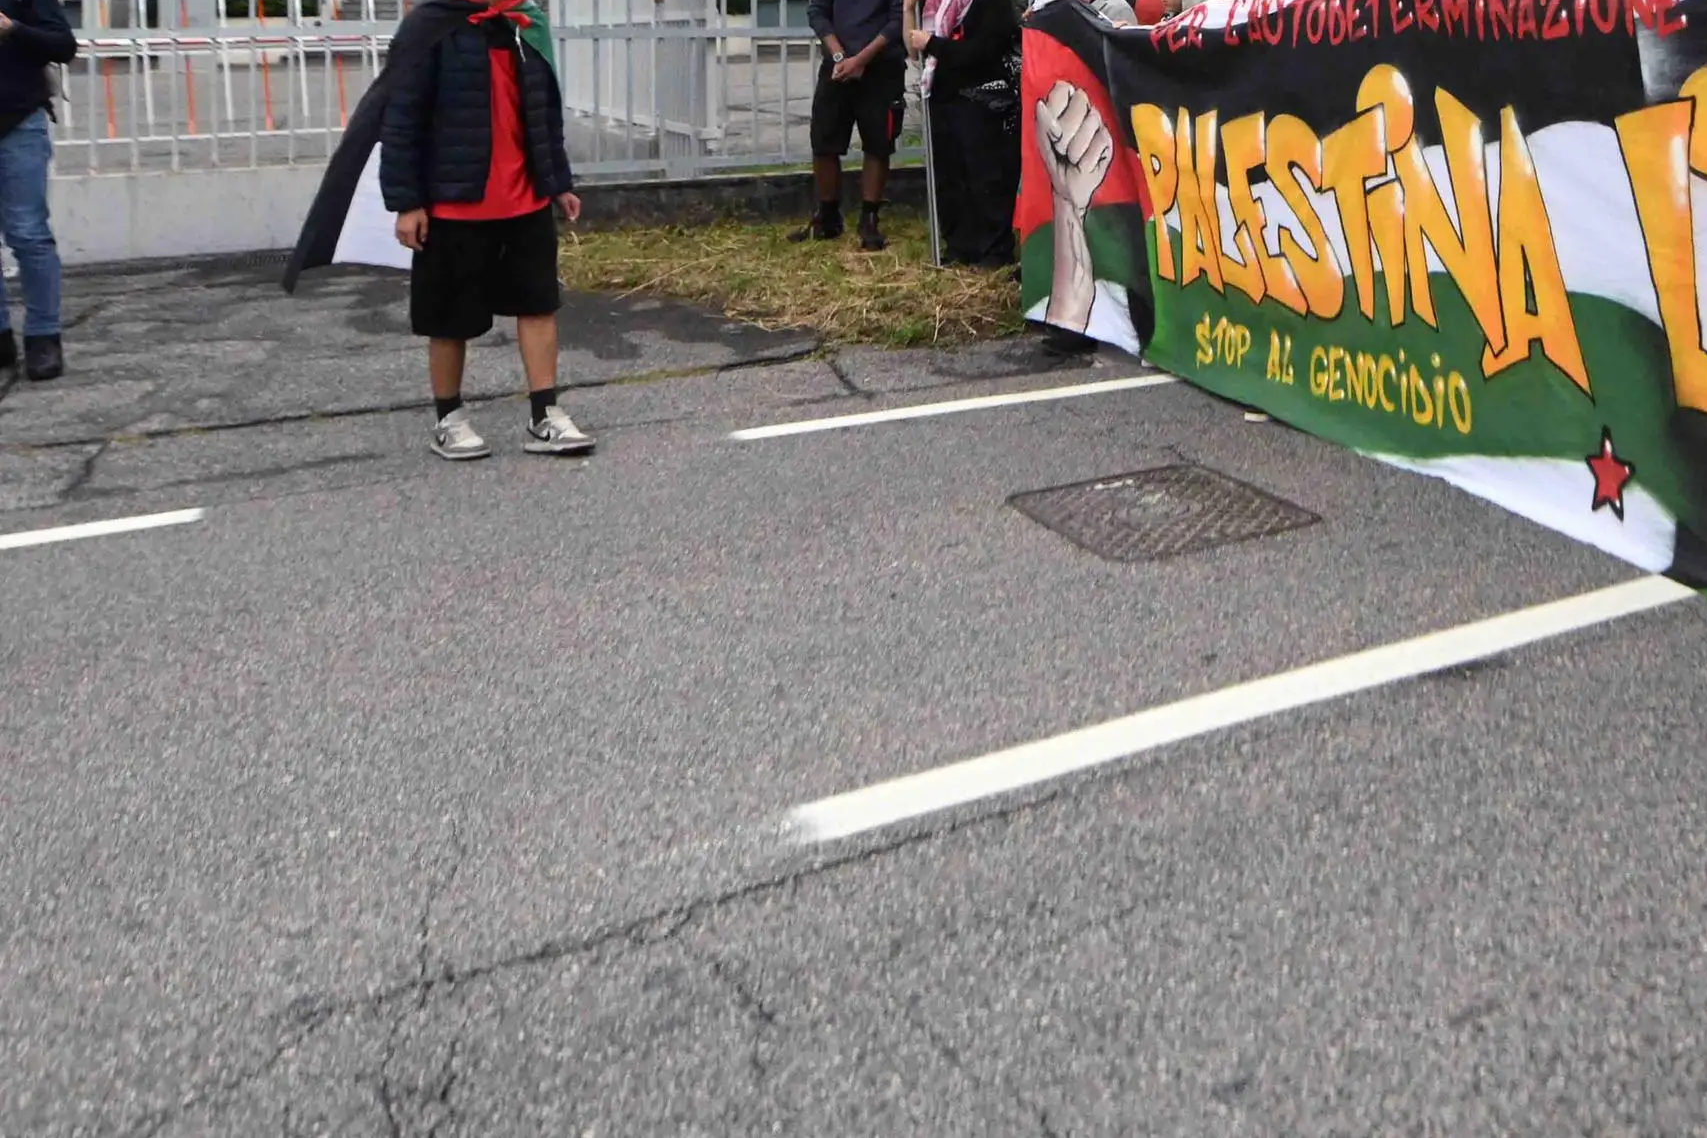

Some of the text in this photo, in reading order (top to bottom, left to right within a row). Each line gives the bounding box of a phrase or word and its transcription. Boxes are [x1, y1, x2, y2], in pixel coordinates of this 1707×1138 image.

[1150, 3, 1208, 53] PER
[1195, 312, 1251, 369] STOP
[1266, 327, 1294, 385] AL
